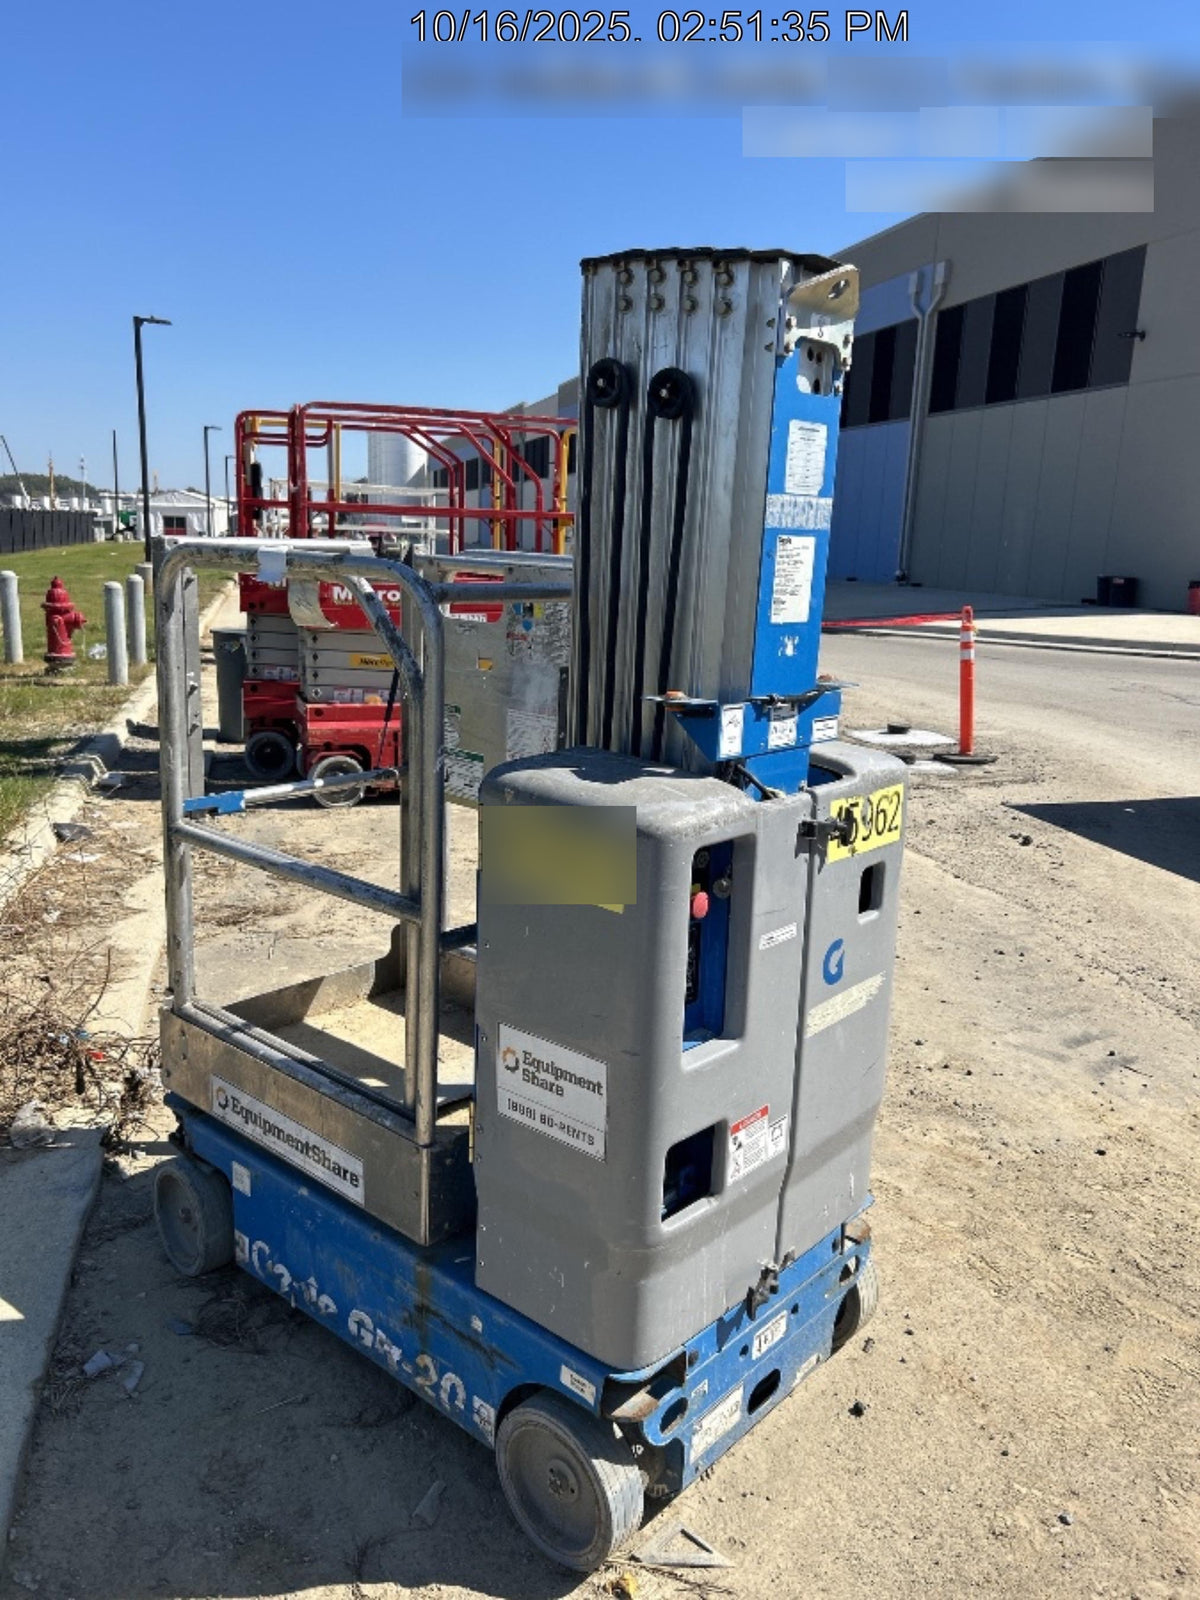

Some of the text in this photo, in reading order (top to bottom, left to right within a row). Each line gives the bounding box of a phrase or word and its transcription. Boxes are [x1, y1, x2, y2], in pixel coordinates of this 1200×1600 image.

[332, 585, 400, 601] Mro
[521, 1050, 604, 1097] Equipment
[521, 1068, 565, 1097] Share
[230, 1095, 360, 1189] EquipmentShare
